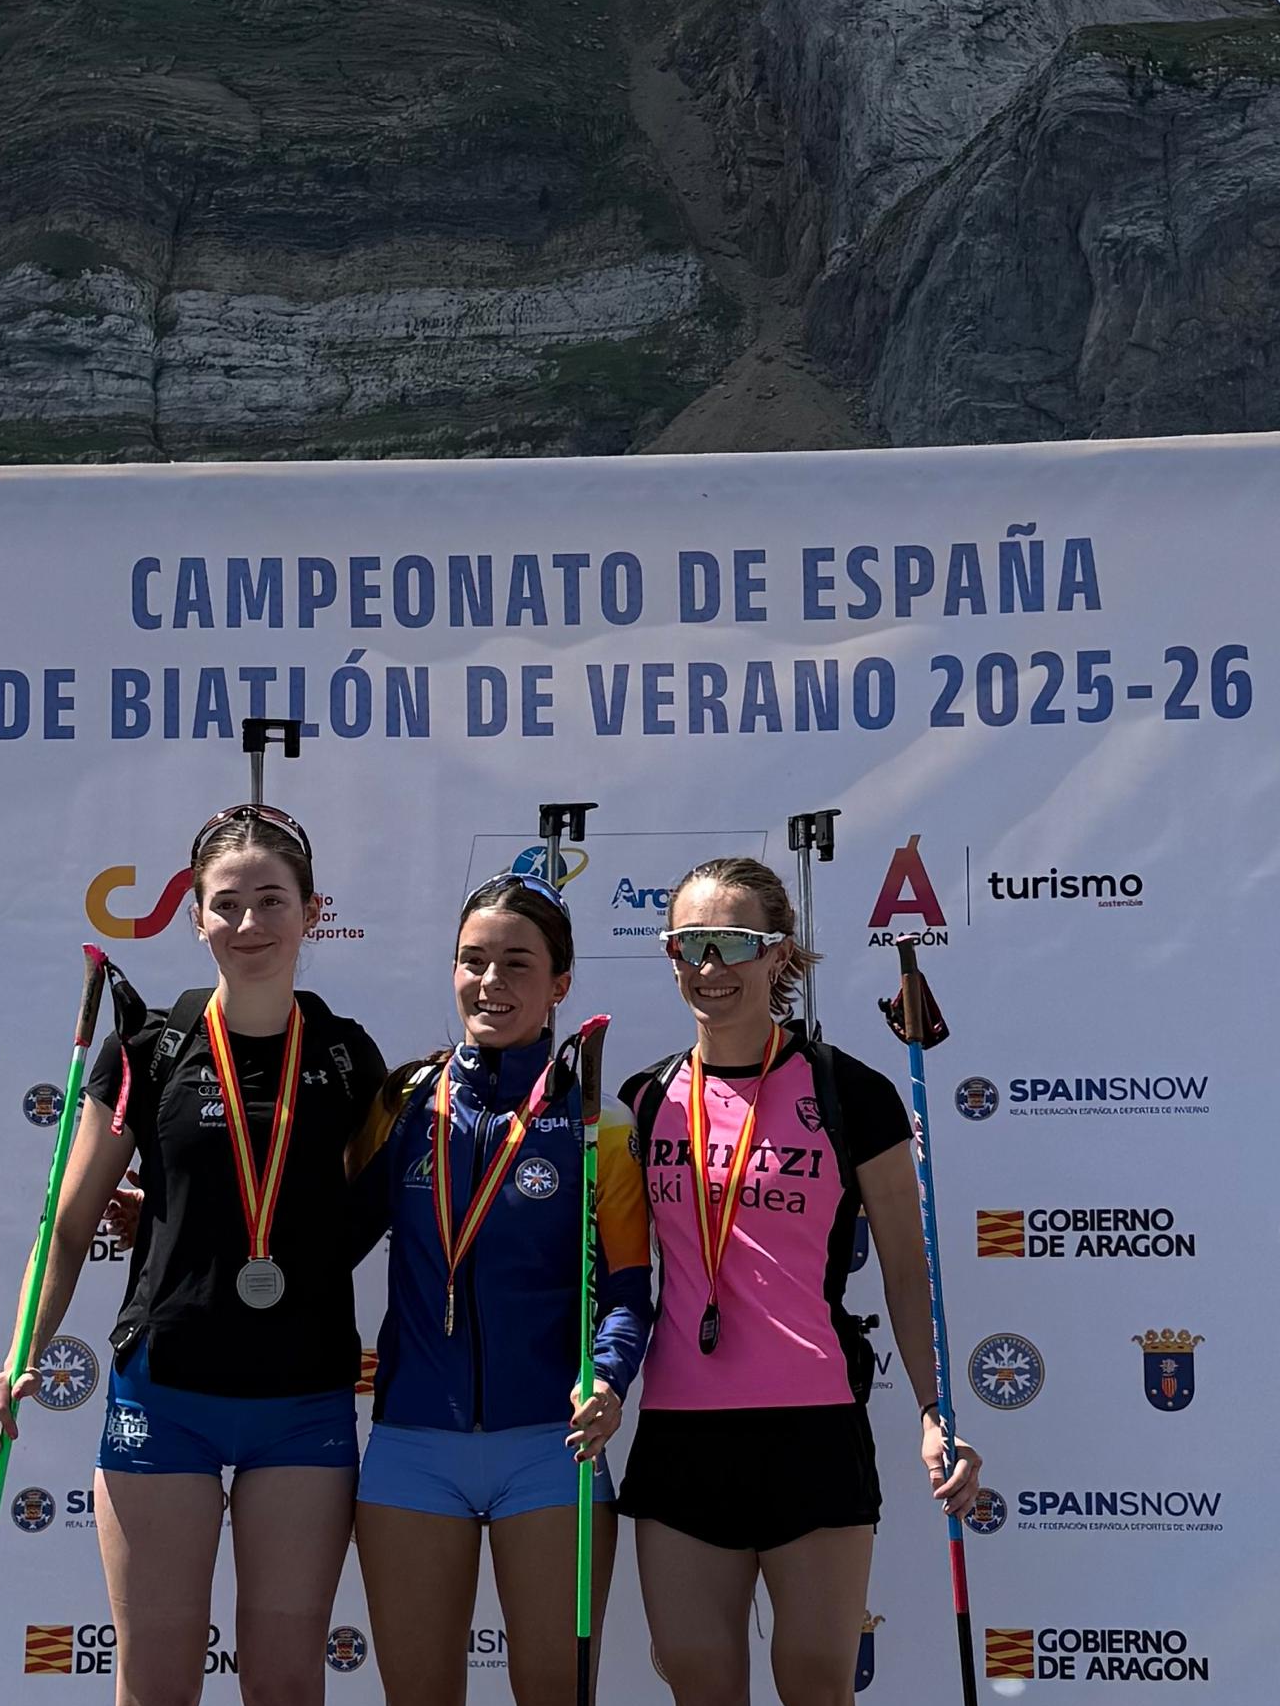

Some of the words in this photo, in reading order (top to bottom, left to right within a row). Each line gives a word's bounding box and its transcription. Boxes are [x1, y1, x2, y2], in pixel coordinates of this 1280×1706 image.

[131, 551, 644, 629] CAMPEONATO
[678, 549, 767, 624] DE
[802, 522, 1102, 621] ESPAÑA
[111, 649, 430, 740] BIATLÓN
[467, 665, 554, 737] DE
[586, 656, 896, 736] VERANO
[929, 643, 1253, 728] 2025-26
[988, 867, 1143, 900] turismo
[1009, 1076, 1209, 1102] SPAINSNOW
[650, 1172, 682, 1204] ski
[1027, 1208, 1174, 1231] GOBIERNO
[90, 1240, 124, 1261] DE
[1028, 1234, 1065, 1257] DE
[1074, 1234, 1196, 1257] ARAGON
[1018, 1491, 1221, 1517] SPAINSNOW
[1037, 1629, 1187, 1654] GOBIERNO
[75, 1652, 112, 1674] DE
[1038, 1655, 1076, 1680] DE
[1086, 1655, 1209, 1681] ARAGON
